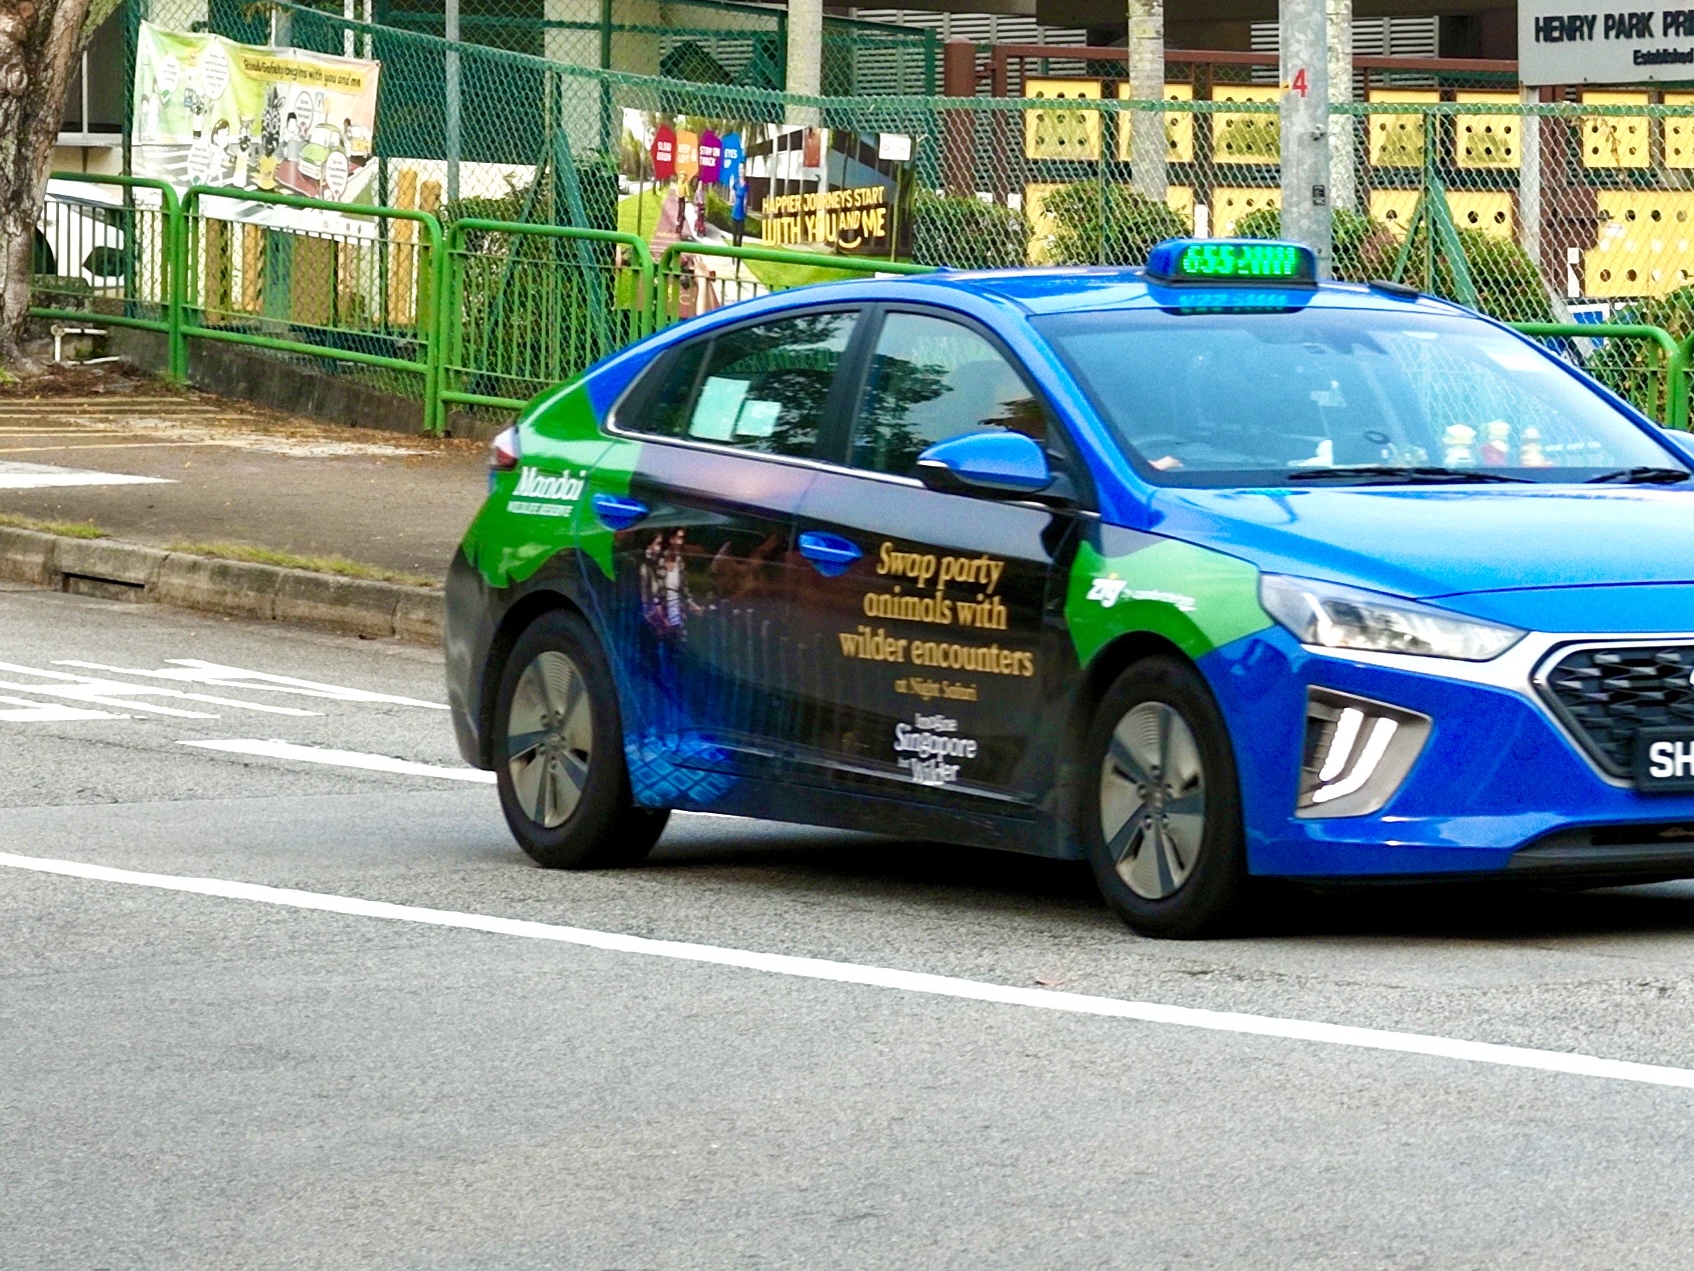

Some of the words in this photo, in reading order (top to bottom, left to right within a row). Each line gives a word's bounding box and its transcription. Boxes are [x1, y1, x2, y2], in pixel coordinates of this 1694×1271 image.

[1534, 14, 1597, 43] HENRY
[1604, 11, 1654, 39] PARK
[1633, 47, 1694, 66] Established
[308, 68, 322, 80] with
[324, 74, 337, 86] you
[337, 72, 349, 86] and
[350, 77, 361, 87] me
[1292, 68, 1308, 98] 4
[723, 159, 732, 169] UP
[762, 194, 801, 214] HAPPIER
[802, 189, 853, 212] JOURNEYS
[855, 185, 885, 208] START
[762, 216, 801, 247] WITH
[805, 211, 837, 244] YOU
[838, 210, 861, 231] AND
[861, 207, 887, 238] ME
[512, 465, 587, 501] Mandai
[876, 541, 936, 588] Swap
[936, 554, 1004, 595] party
[863, 585, 952, 624] animals
[954, 593, 1008, 630] with
[838, 624, 908, 663] wilder
[911, 643, 1035, 677] encounters
[894, 679, 908, 694] at
[909, 677, 940, 701] Night
[893, 722, 978, 762] Singapore
